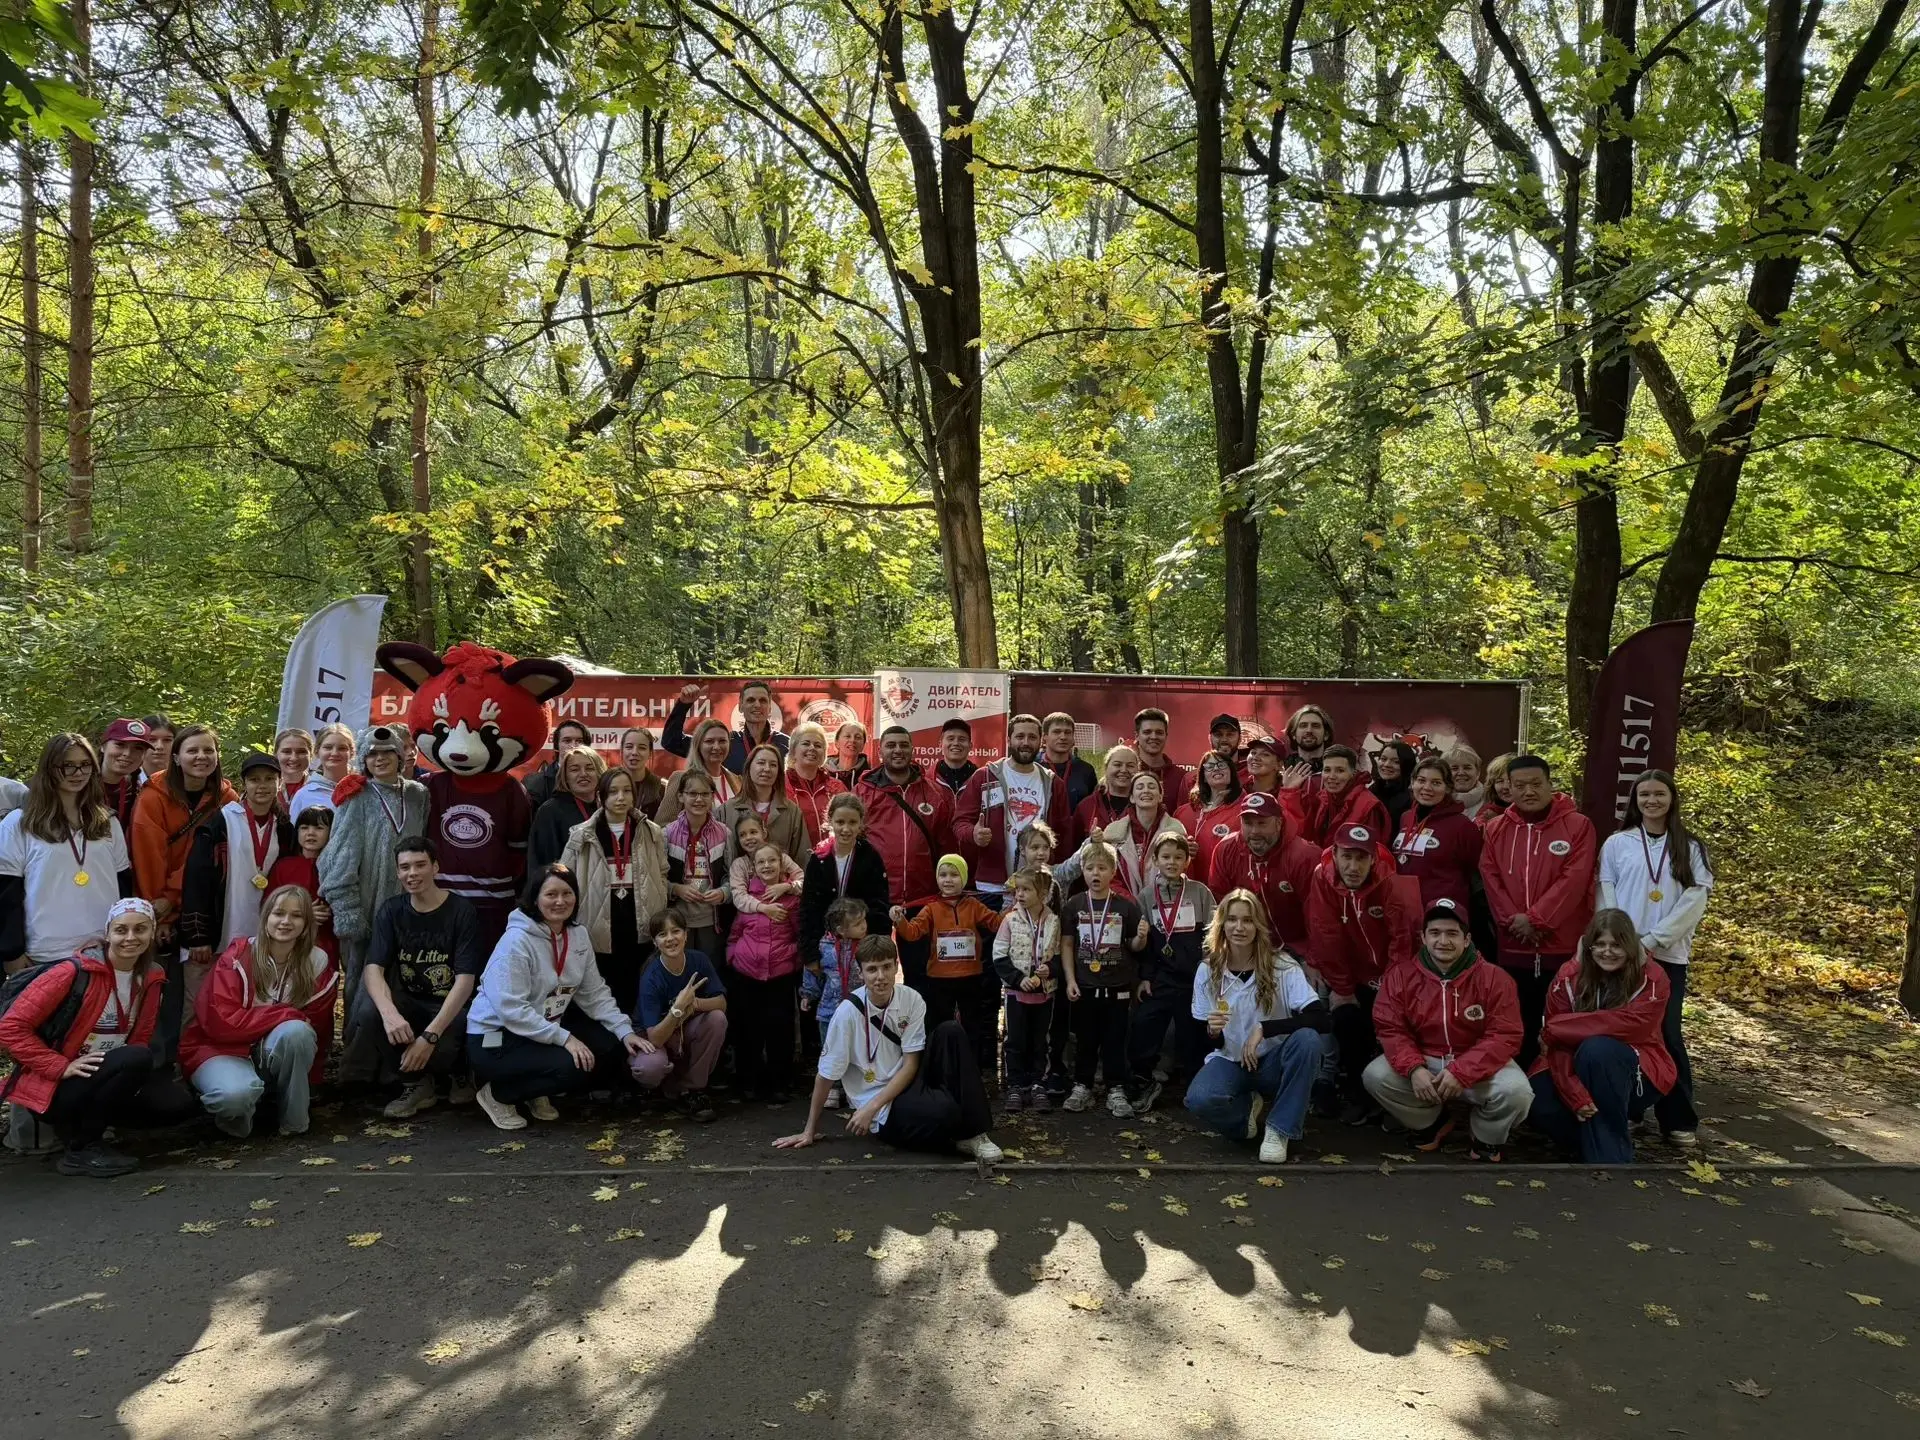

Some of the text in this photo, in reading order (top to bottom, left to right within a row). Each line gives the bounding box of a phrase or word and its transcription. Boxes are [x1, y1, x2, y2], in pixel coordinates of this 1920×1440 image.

[927, 685, 1001, 697] ДВИГАТЕЛЬ
[313, 667, 346, 737] 517
[927, 698, 976, 710] ДОБРА!
[953, 941, 965, 950] 126
[415, 949, 448, 964] Litter
